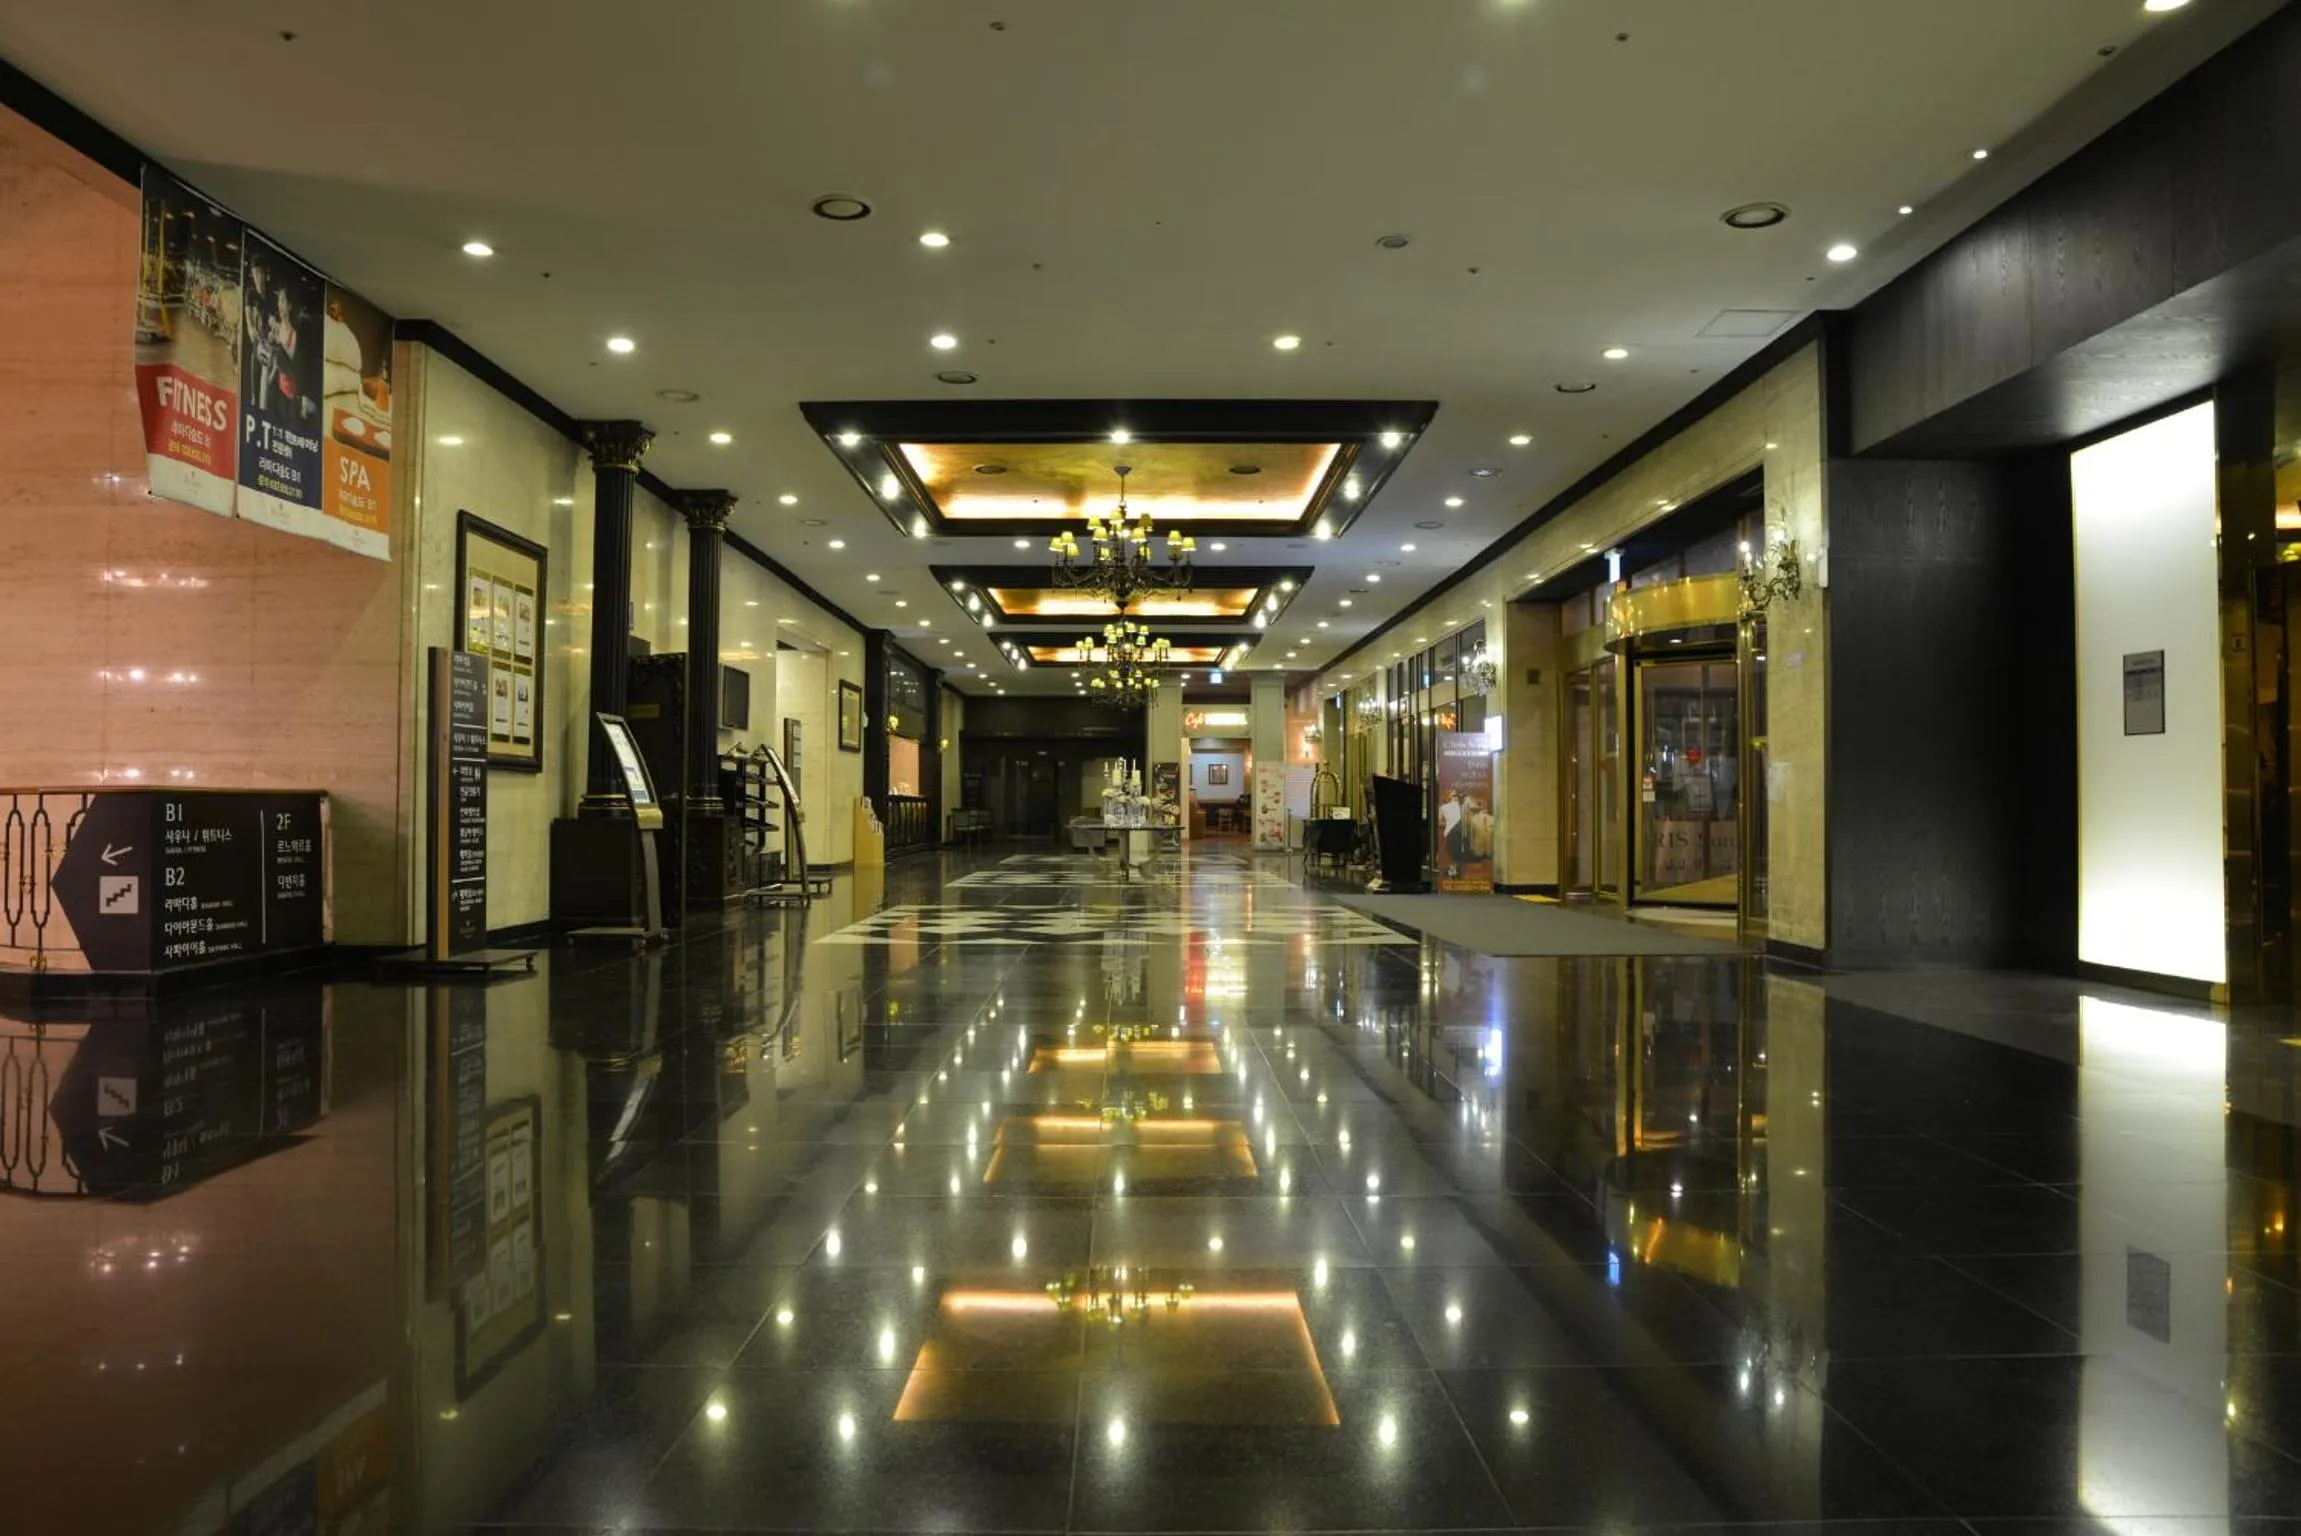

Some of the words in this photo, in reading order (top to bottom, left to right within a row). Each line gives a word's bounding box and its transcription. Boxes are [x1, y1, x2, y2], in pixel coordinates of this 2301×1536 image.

[156, 375, 228, 431] FITNESS
[246, 414, 271, 450] P.T
[340, 456, 371, 492] SPA
[166, 803, 182, 822] B1
[276, 813, 291, 831] 2F
[165, 828, 190, 844] 사우나
[165, 867, 185, 886] B2
[165, 896, 198, 912] 라마다홀
[165, 917, 214, 936] 다이아몬드홀
[164, 940, 206, 959] 사파이어홀
